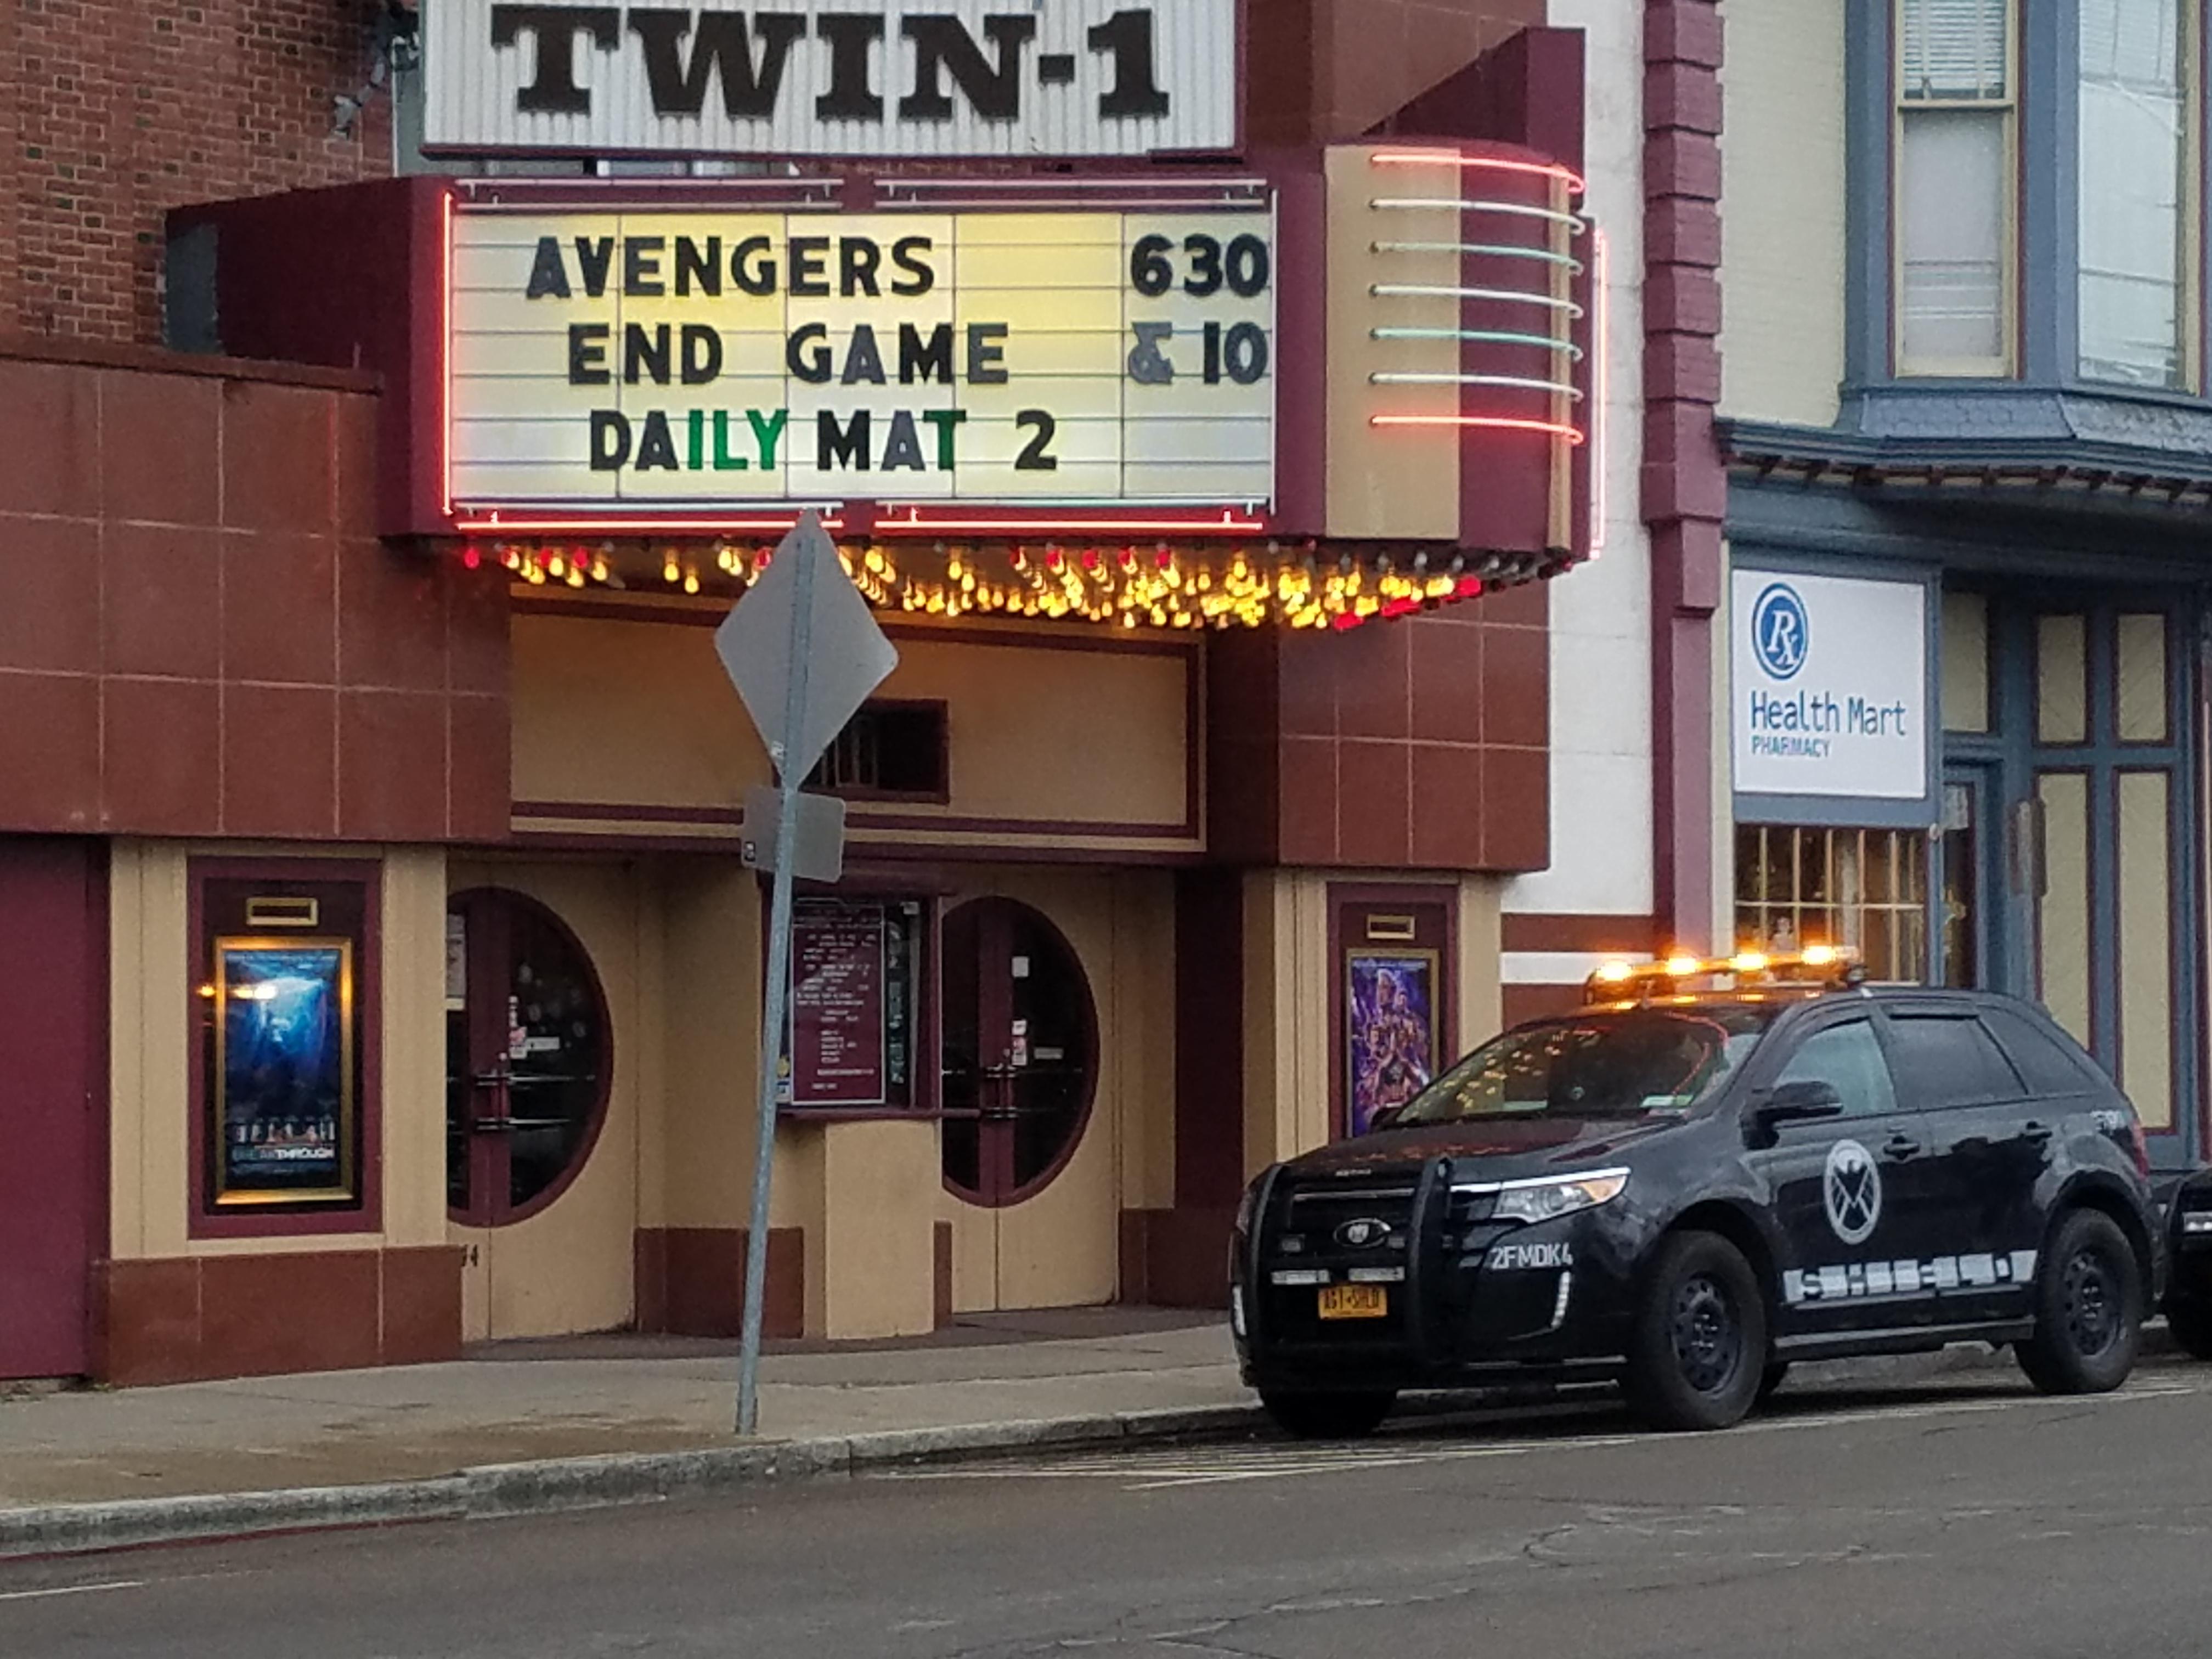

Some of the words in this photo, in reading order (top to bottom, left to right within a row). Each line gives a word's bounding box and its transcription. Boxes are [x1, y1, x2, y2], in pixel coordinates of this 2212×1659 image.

[490, 5, 1170, 123] TWIN-1
[526, 235, 935, 300] AVENGERS
[1130, 233, 1268, 297] 630
[567, 321, 724, 385] END
[786, 321, 1009, 386] GAME
[1127, 322, 1173, 385] &
[1203, 320, 1268, 385] 10
[590, 409, 789, 471] DAILY
[817, 409, 967, 471] MAT
[1014, 409, 1057, 471] 2
[1751, 689, 1839, 733] Health
[1847, 696, 1907, 736] Mart
[1751, 735, 1831, 758] PHARMACY
[1489, 1242, 1574, 1269] 2FMDK4
